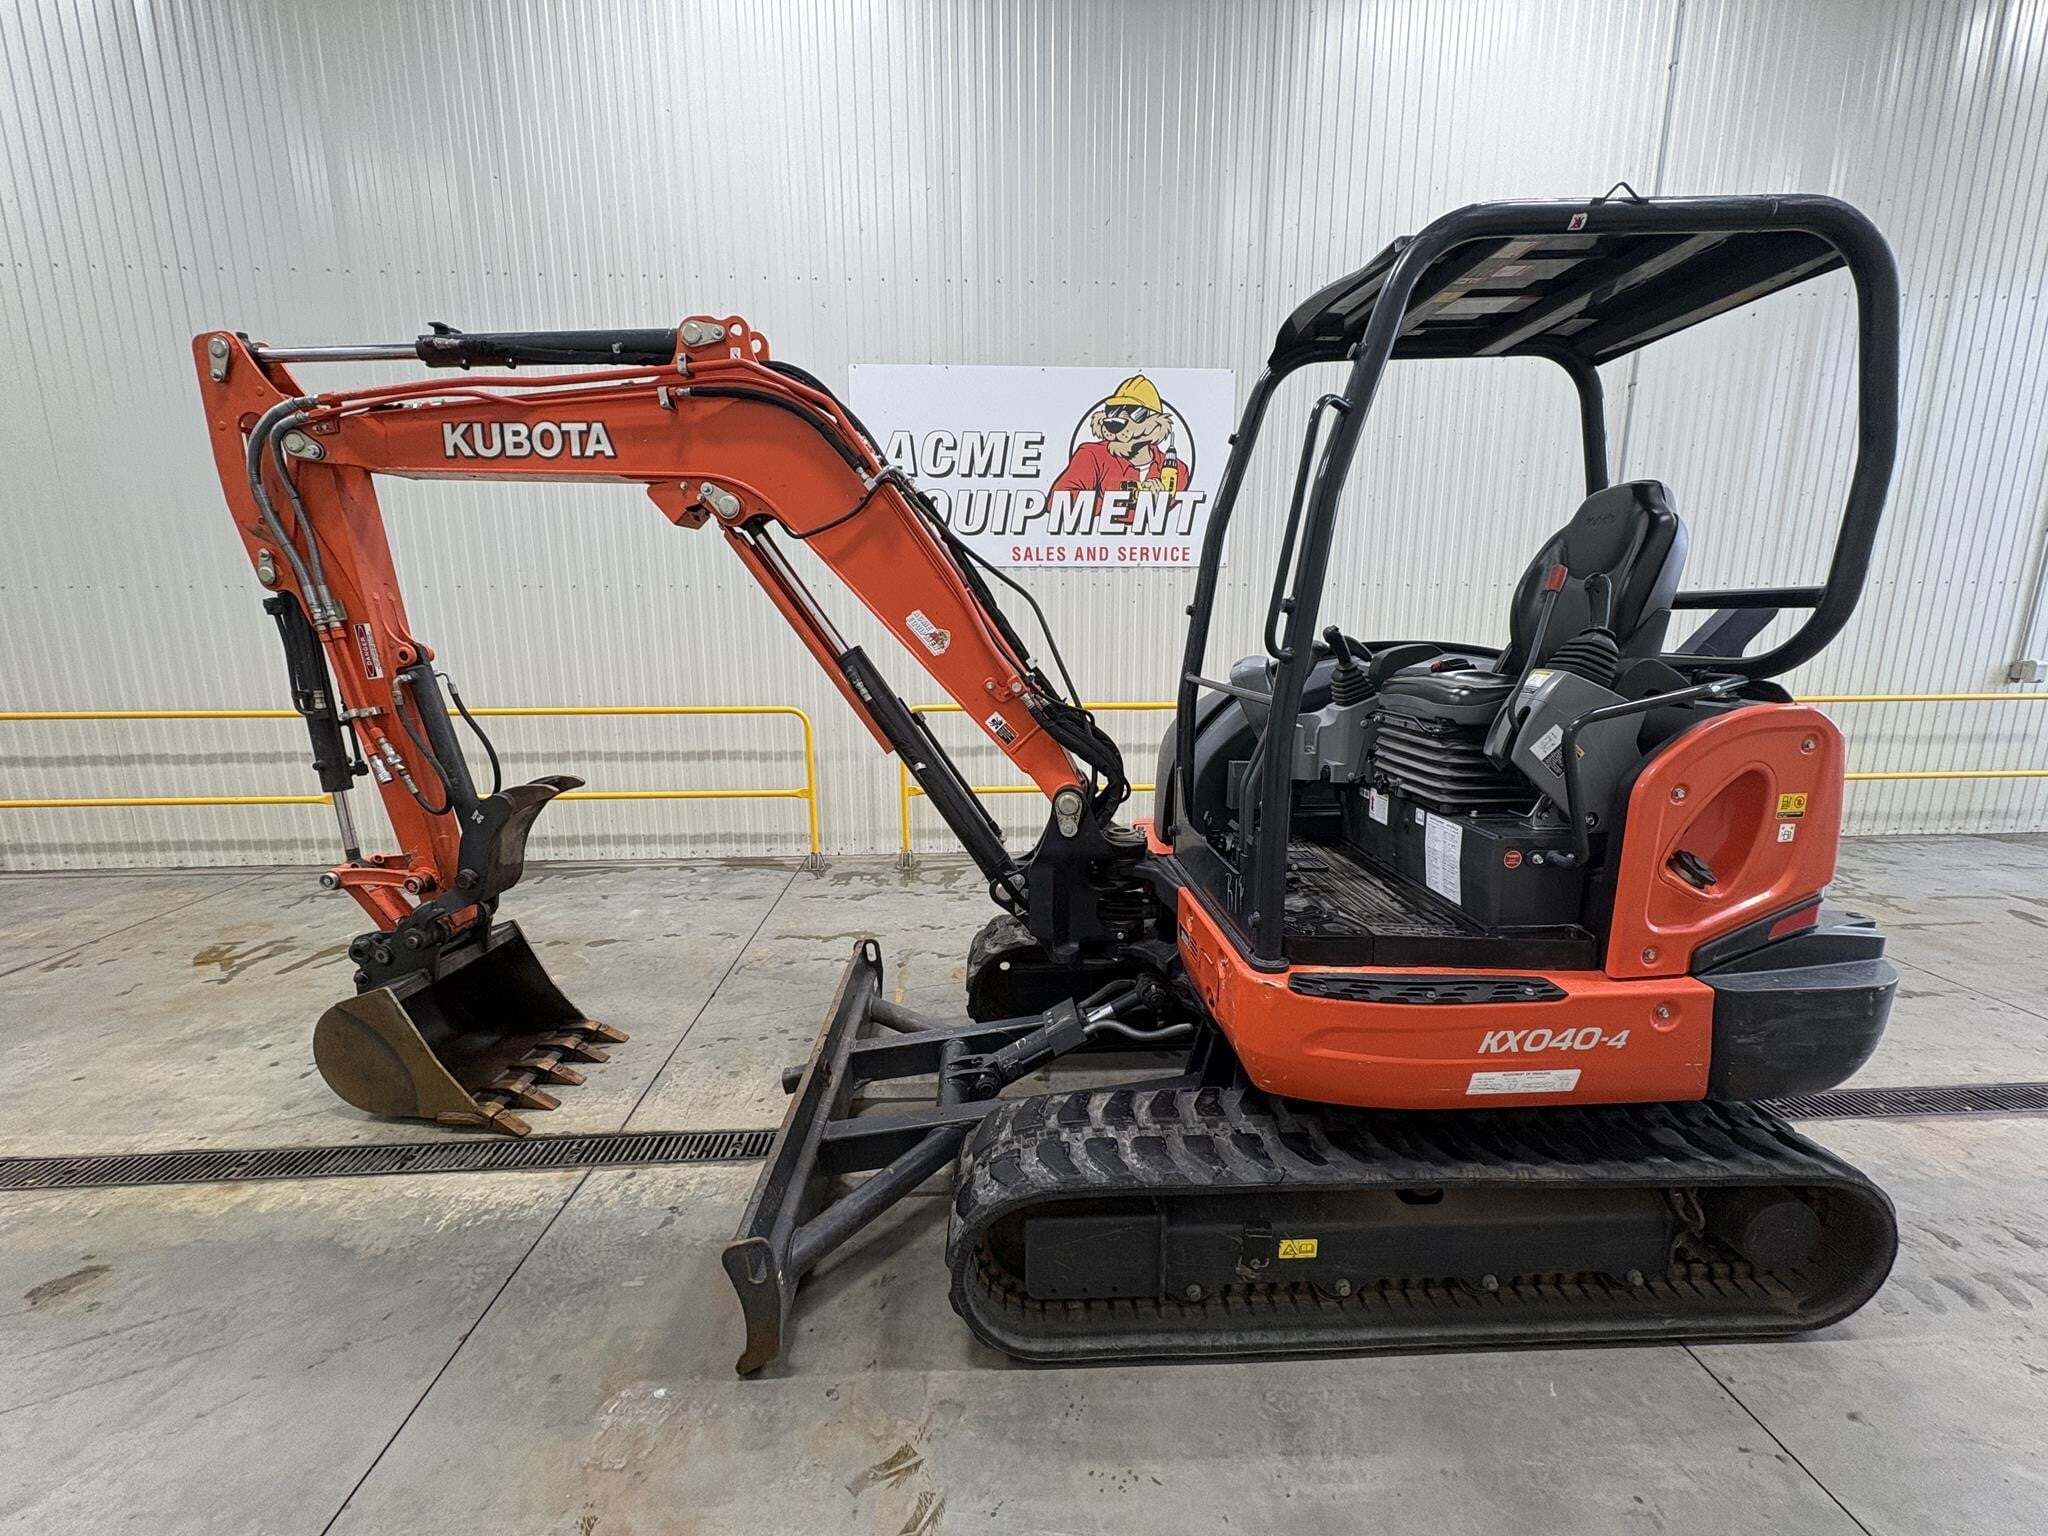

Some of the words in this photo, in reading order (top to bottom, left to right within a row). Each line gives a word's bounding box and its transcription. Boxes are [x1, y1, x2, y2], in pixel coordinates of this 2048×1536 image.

[442, 421, 616, 458] KUBOTA
[884, 430, 1045, 478] ACME
[921, 488, 1207, 536] UIPMENT
[1012, 546, 1066, 562] SALES
[1074, 546, 1109, 562] AND
[1117, 546, 1191, 562] SERVICE
[360, 637, 373, 666] DANGER
[1477, 1027, 1631, 1054] KX040-4
